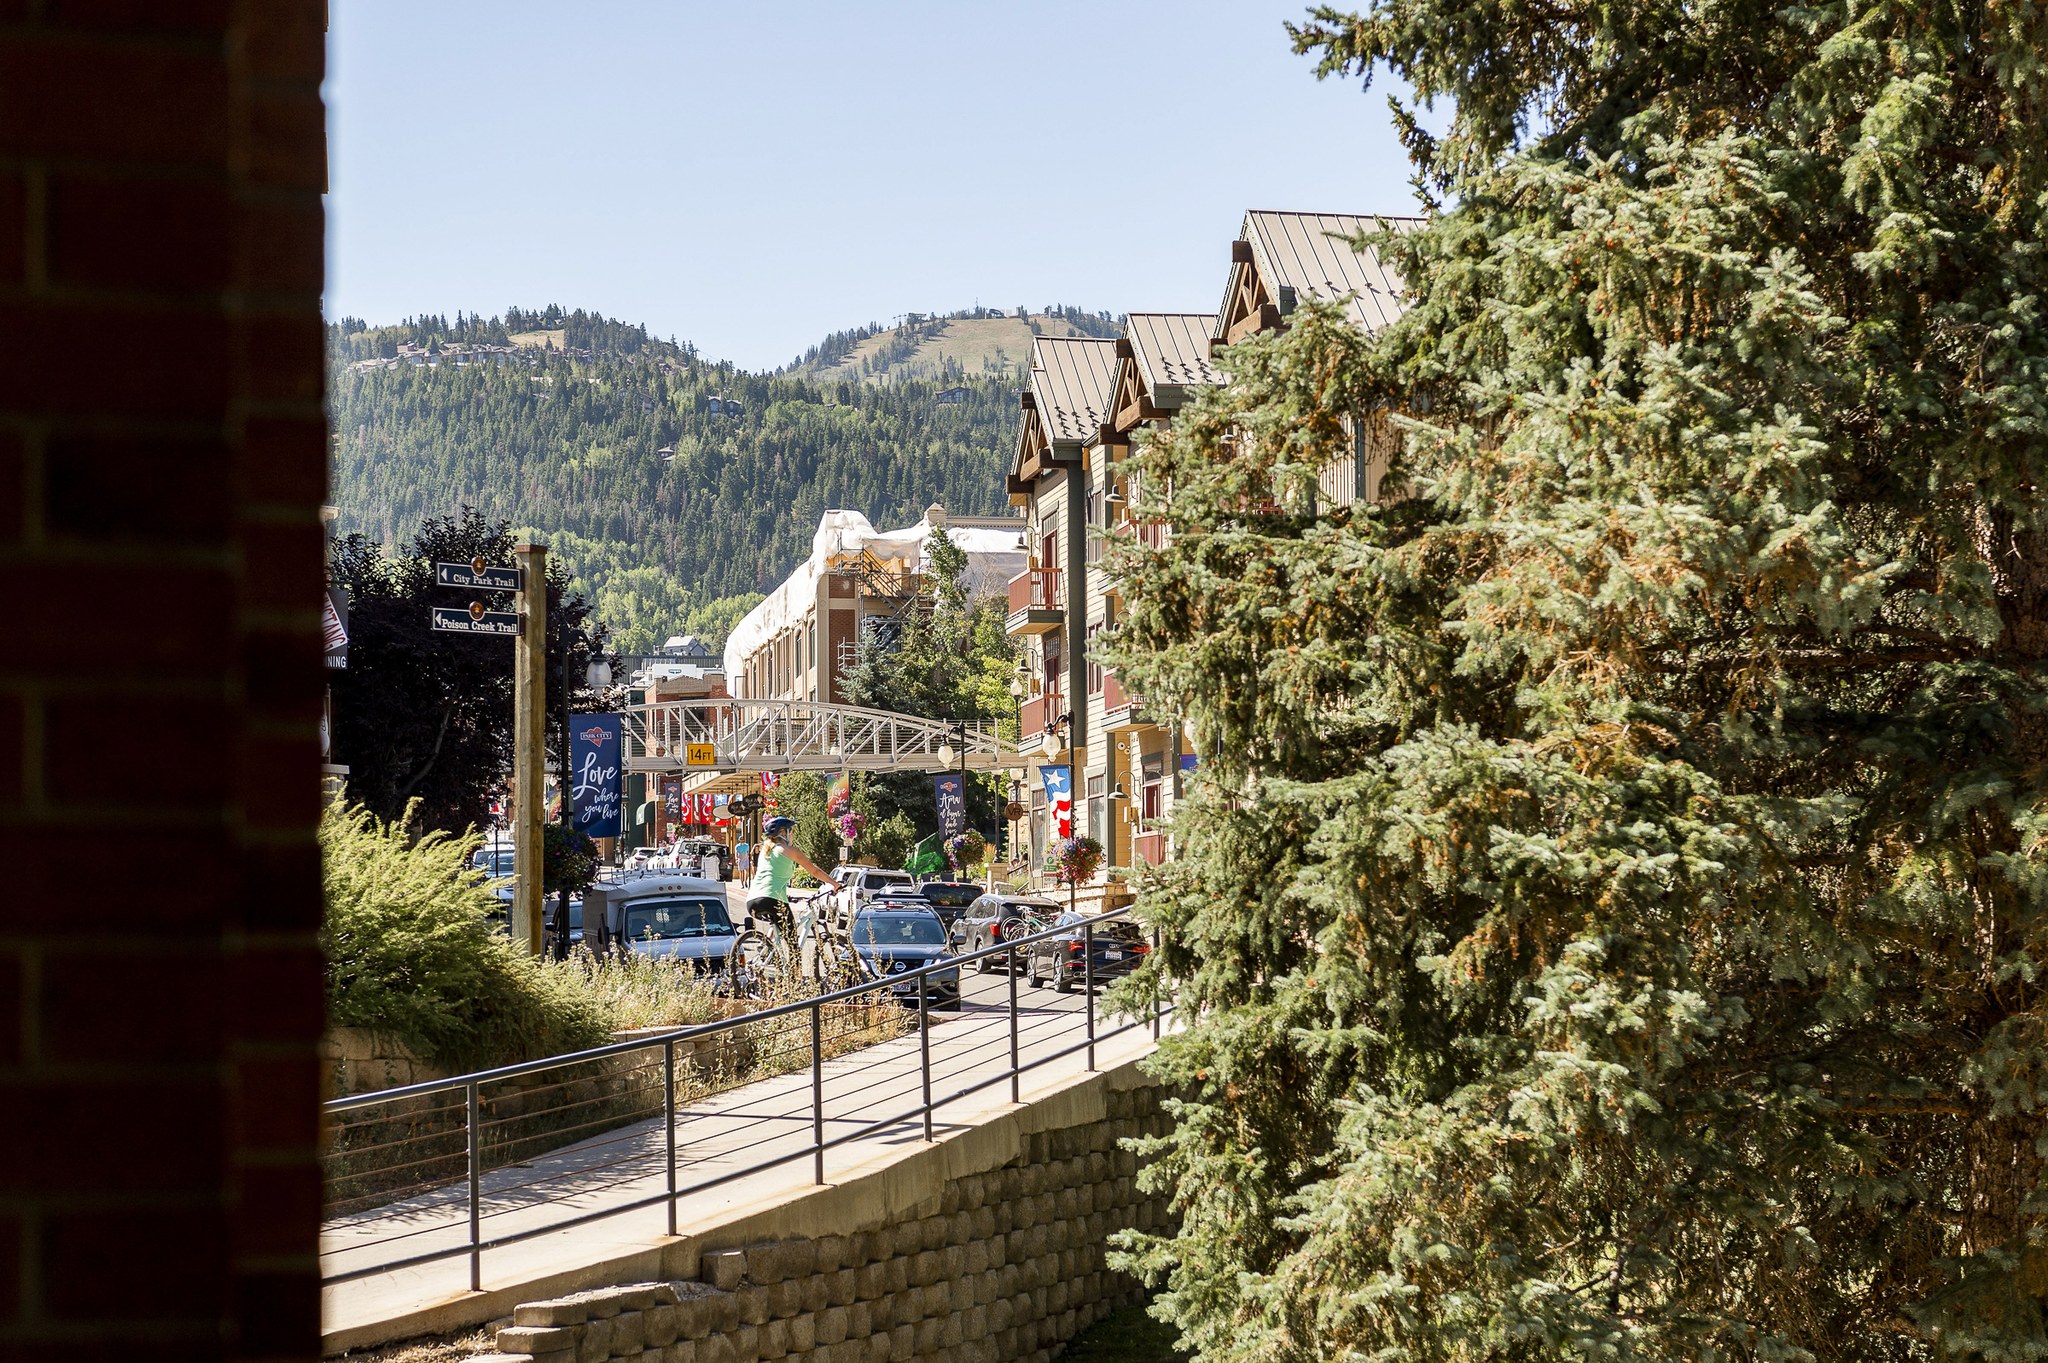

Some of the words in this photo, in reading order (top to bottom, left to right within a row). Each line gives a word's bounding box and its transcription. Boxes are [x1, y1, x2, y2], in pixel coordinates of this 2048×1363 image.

[453, 573, 471, 585] City
[473, 575, 493, 586] Park
[494, 577, 515, 587] Trail
[441, 618, 469, 630] Poison
[471, 621, 496, 632] Creek
[496, 622, 518, 633] Trail
[572, 752, 618, 800] Love
[594, 787, 619, 804] where
[828, 782, 847, 803] Love
[581, 804, 602, 823] you
[601, 804, 619, 820] live
